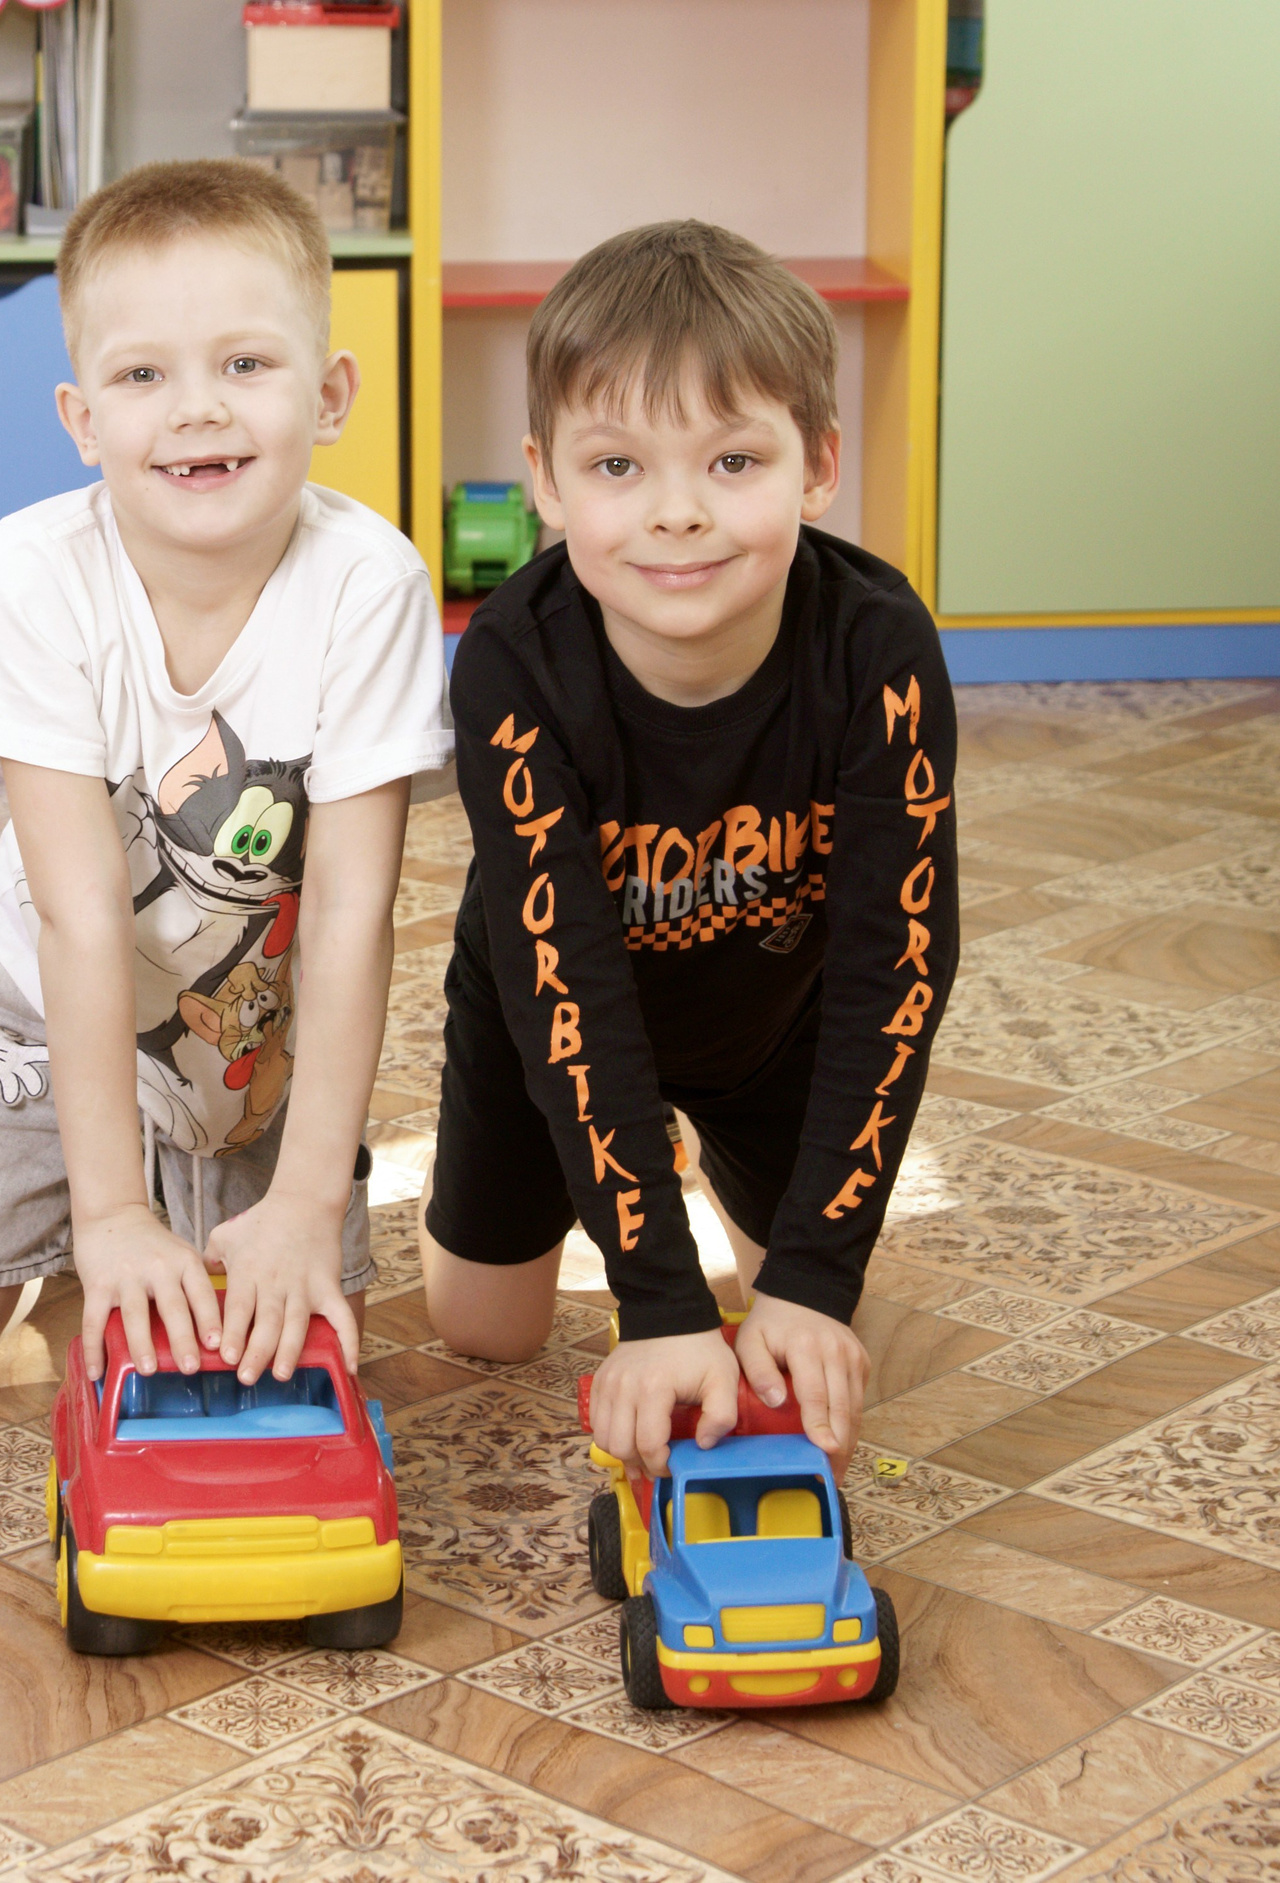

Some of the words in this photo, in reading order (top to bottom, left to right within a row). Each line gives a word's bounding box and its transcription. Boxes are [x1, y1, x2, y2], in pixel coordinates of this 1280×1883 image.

[599, 800, 836, 896] OTORBIKE
[622, 857, 768, 925] RIDERS
[490, 713, 643, 1253] MOTORBIKE
[822, 674, 951, 1220] MOTORBIKE
[877, 1462, 897, 1477] 2
